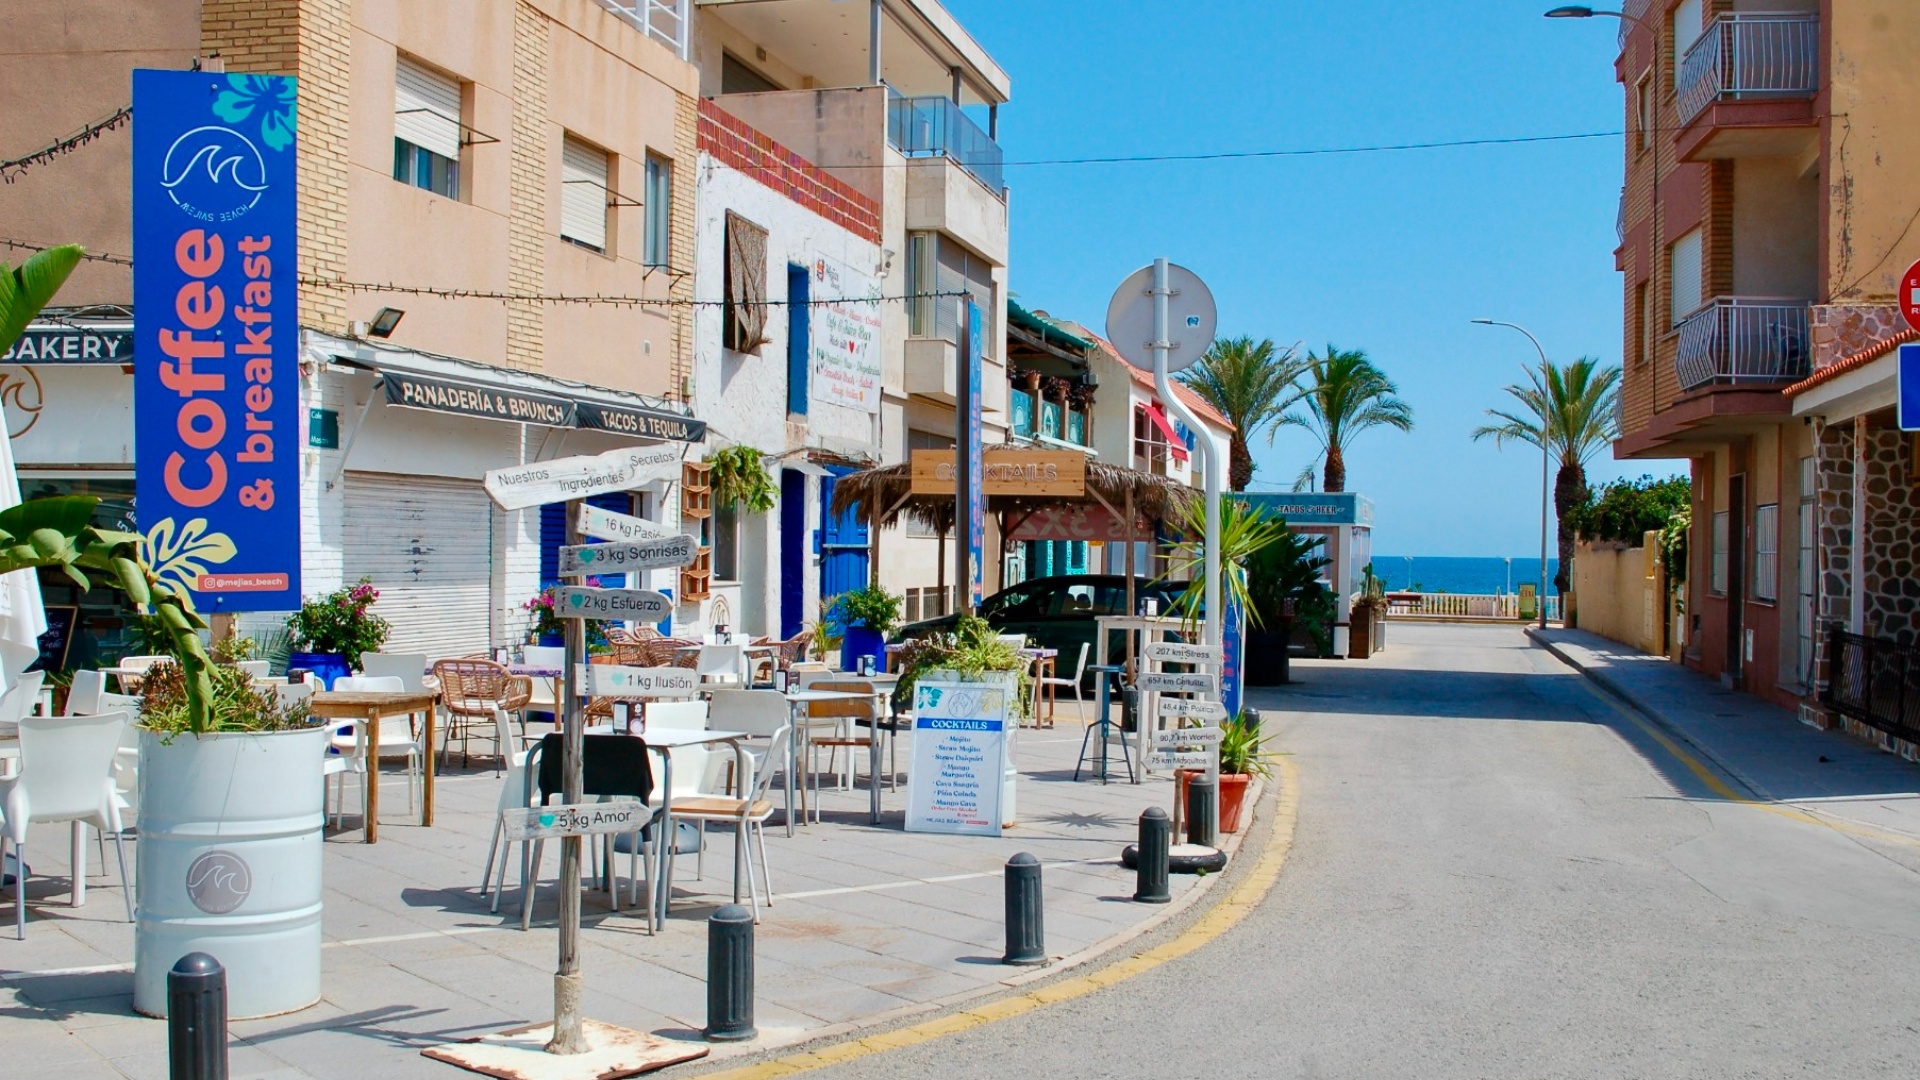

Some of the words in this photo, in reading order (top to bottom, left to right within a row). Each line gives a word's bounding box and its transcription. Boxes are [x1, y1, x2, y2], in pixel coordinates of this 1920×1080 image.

[220, 204, 249, 222] BEACH
[235, 235, 274, 462] breakfast
[159, 229, 228, 507] Coffee
[402, 382, 493, 413] PANADERÍA
[496, 395, 507, 414] &
[509, 397, 564, 424] BRUNCH
[601, 410, 637, 432] TACOS
[639, 416, 647, 433] &
[647, 418, 689, 439] TEQUILA
[498, 468, 549, 487] Nuestros
[559, 471, 624, 493] Ingredientes
[630, 452, 675, 467] Secretos
[935, 463, 1057, 481] CKTAILS
[239, 478, 275, 511] &
[1279, 505, 1305, 514] TACOS
[605, 518, 617, 531] 16
[620, 521, 632, 537] kg
[596, 549, 604, 562] 3
[609, 547, 625, 564] kg
[629, 545, 688, 560] Sonrisas
[216, 577, 283, 588] @mejias_beach
[584, 596, 591, 608] 2
[594, 595, 607, 611] kg
[611, 594, 661, 611] Esfuerzo
[1156, 647, 1170, 656] 207
[1172, 648, 1183, 656] km
[1185, 649, 1210, 659] Stress
[627, 674, 633, 686] 1
[637, 674, 652, 689] kg
[655, 674, 692, 689] Ilusión
[931, 719, 988, 730] COCKTAILS
[956, 755, 984, 763] Daiquiri
[941, 771, 975, 779] Margarita
[559, 814, 568, 827] 5
[572, 814, 589, 829] kg
[593, 811, 631, 825] Amor
